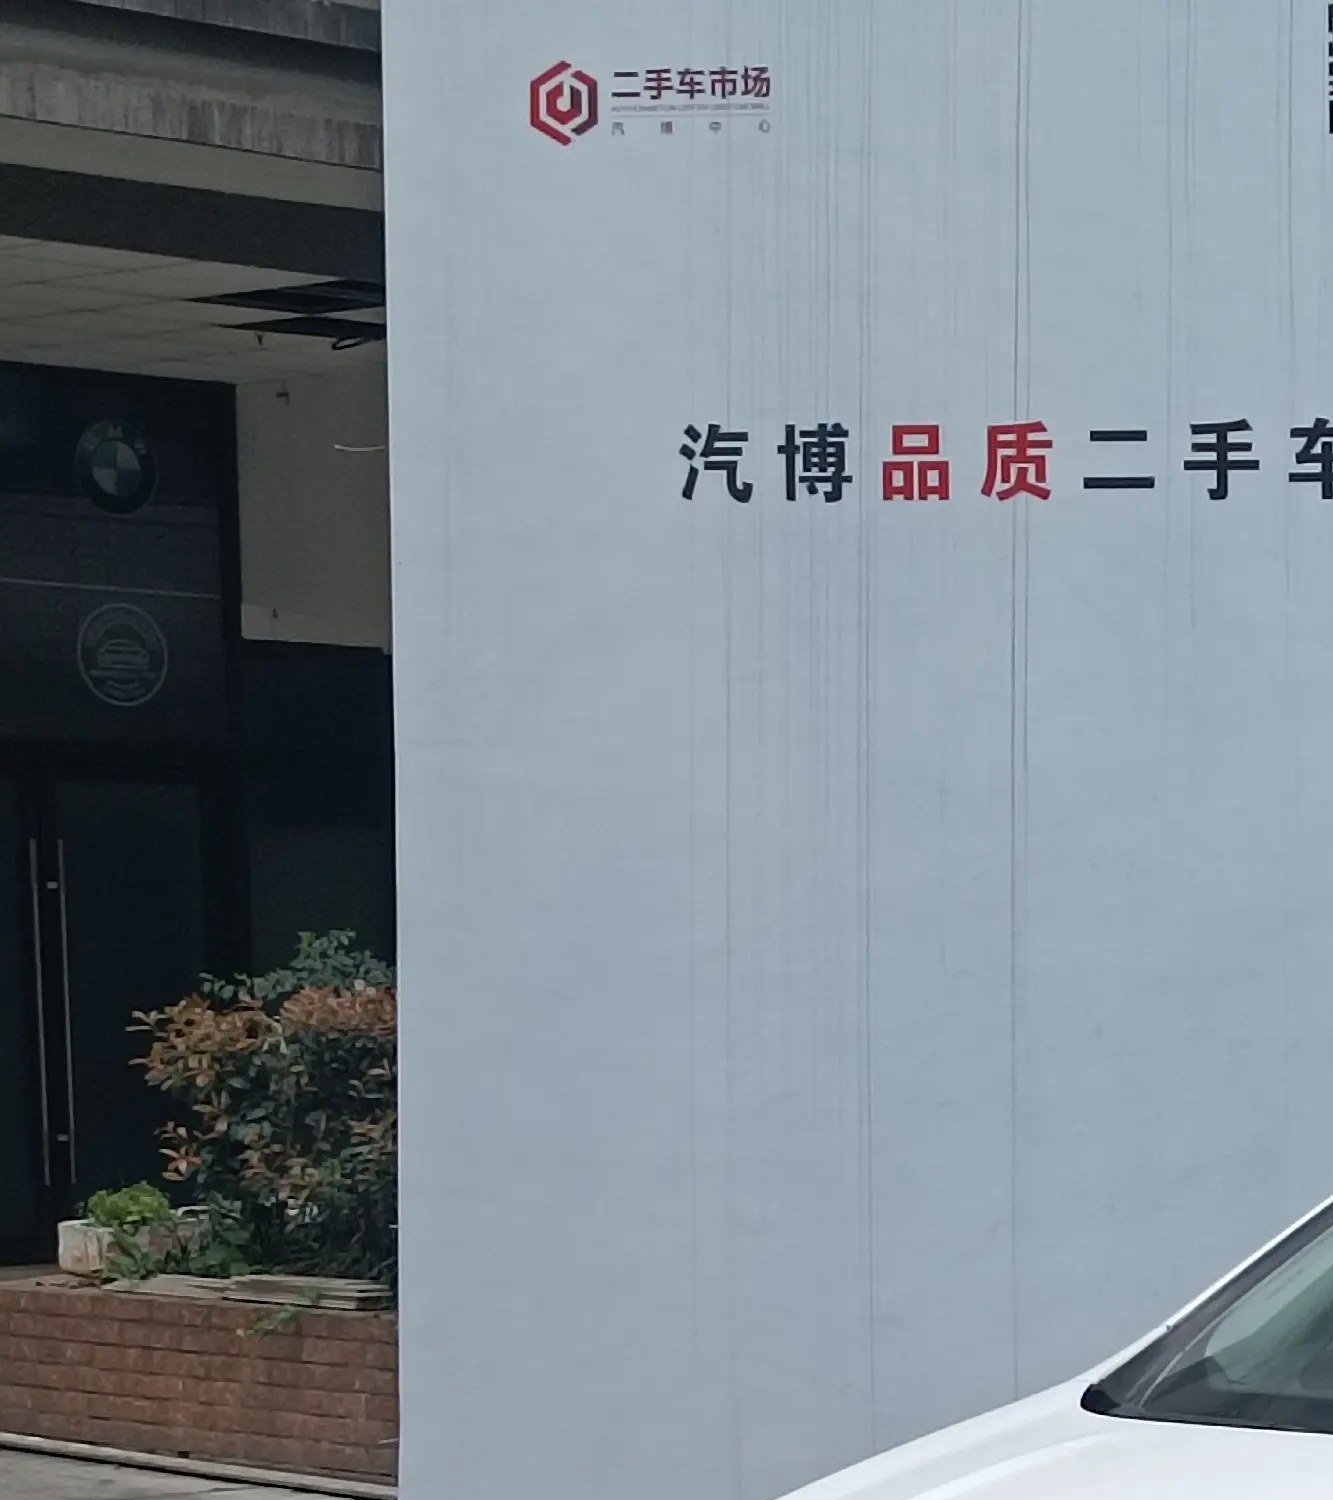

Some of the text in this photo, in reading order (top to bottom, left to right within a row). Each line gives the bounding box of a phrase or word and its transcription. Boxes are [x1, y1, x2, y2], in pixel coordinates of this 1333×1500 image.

[611, 65, 771, 100] 二手车市场
